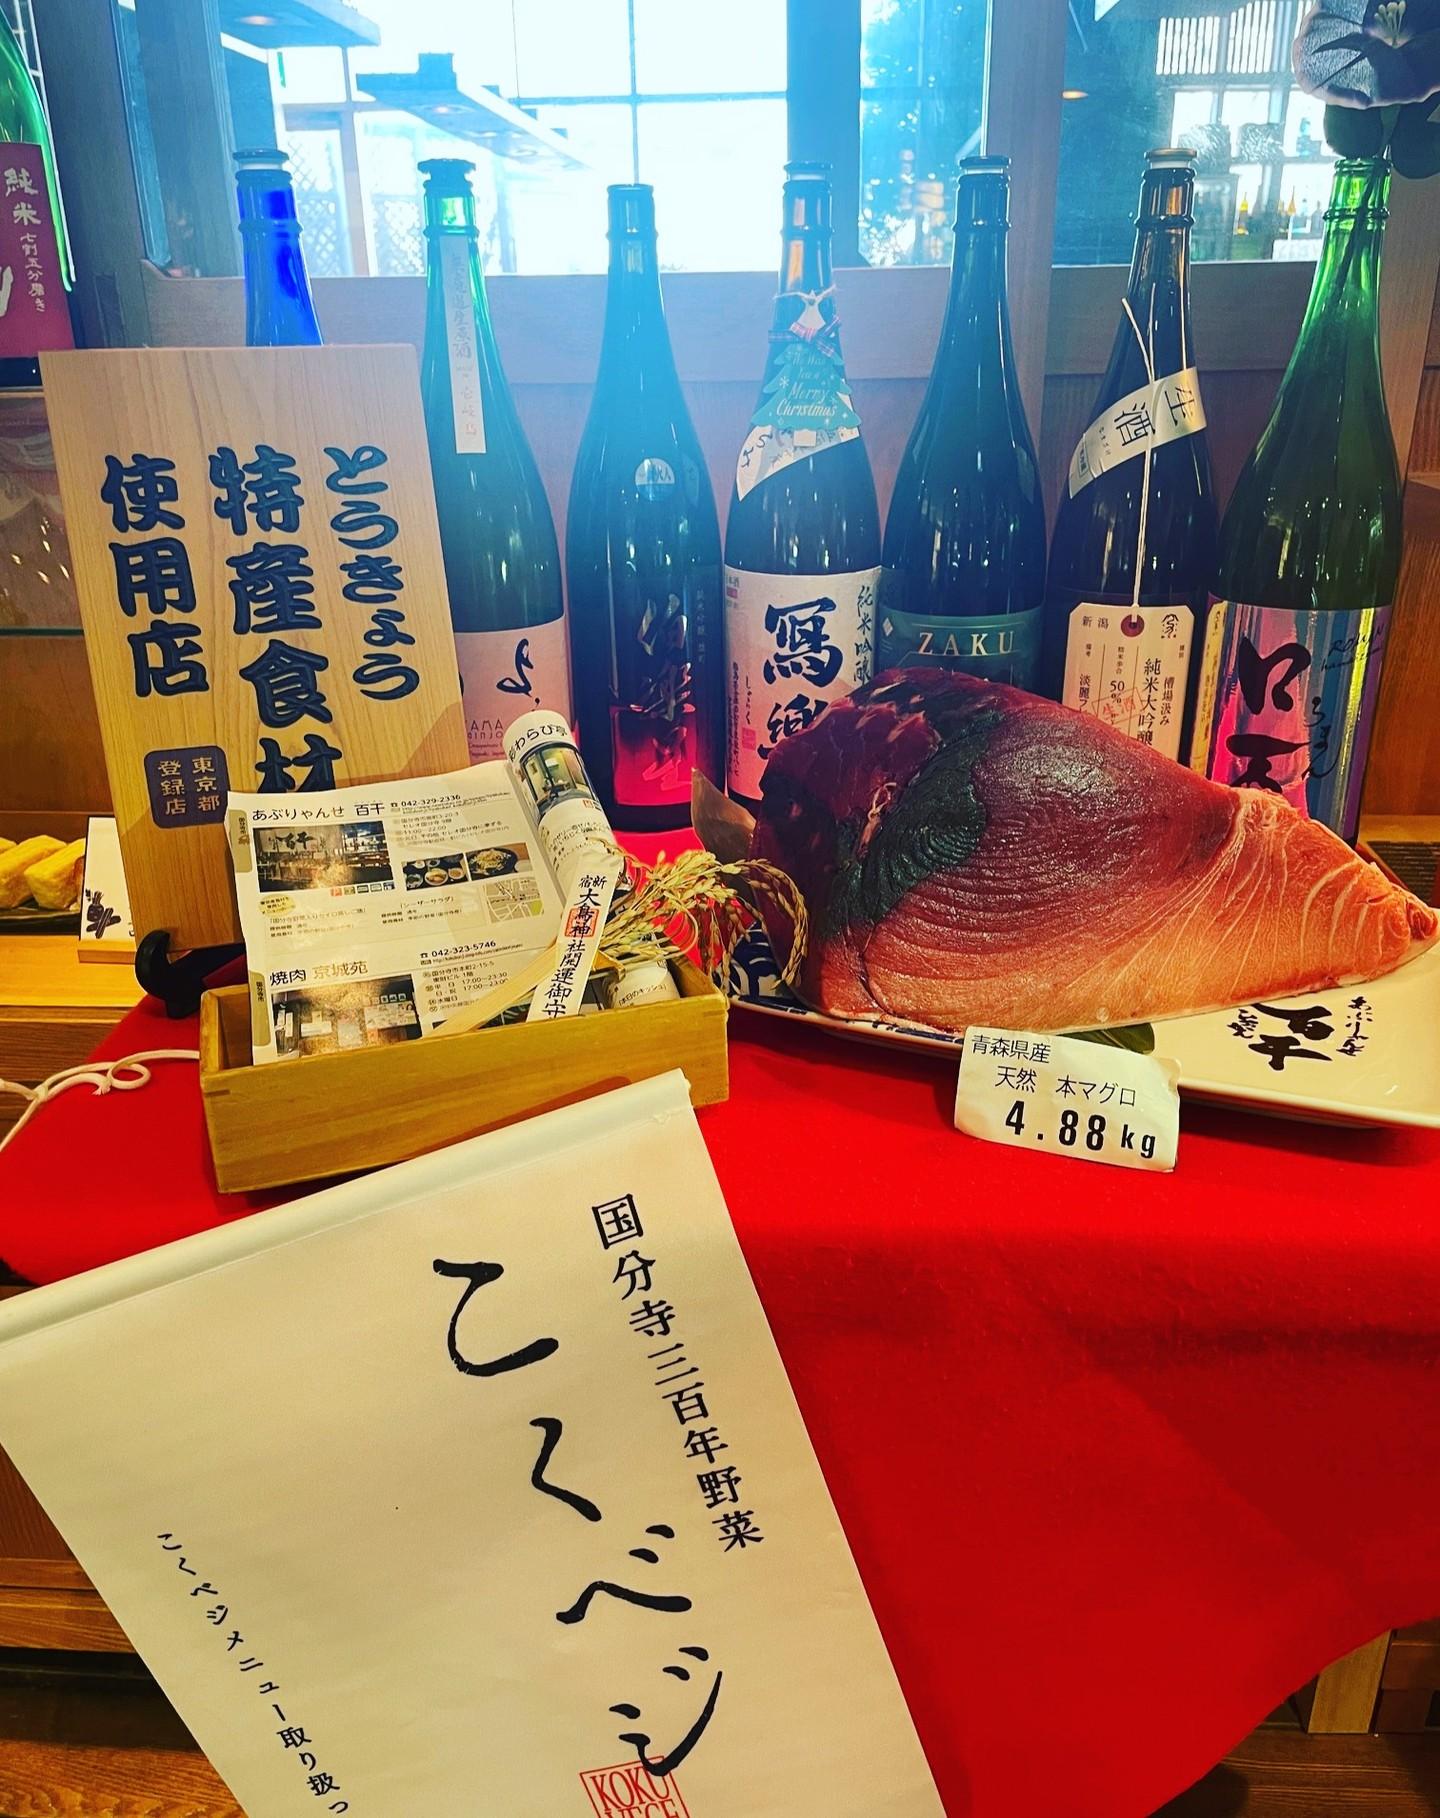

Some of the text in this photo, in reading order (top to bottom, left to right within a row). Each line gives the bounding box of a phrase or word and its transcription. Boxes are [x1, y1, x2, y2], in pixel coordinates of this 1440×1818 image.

[776, 398, 838, 417] Christmas
[787, 382, 829, 404] Merry
[1113, 385, 1195, 447] 生酒
[100, 453, 210, 699] 使用店
[323, 445, 421, 701] とうきょう
[208, 443, 343, 794] 特産食材
[1081, 615, 1109, 630] 新潟
[917, 630, 1015, 657] ZAKU
[495, 637, 541, 712] よ
[1136, 657, 1162, 746] 純米大吟醸
[465, 718, 504, 731] AMA
[157, 758, 187, 817] 登録店
[192, 756, 222, 812] 東京都
[400, 793, 462, 808] 042-329-2336
[252, 805, 345, 821] あぶりゃんせ
[431, 939, 497, 958] 042-323-5746
[269, 960, 369, 986] 焼肉 京城苑
[971, 1034, 1052, 1064] 青森県産
[995, 1065, 1137, 1107] 天然 本マグロ
[1005, 1100, 1157, 1160] 4.88 kg
[591, 1193, 765, 1553] 国分寺三百年野菜
[589, 1765, 670, 1812] KOKU
